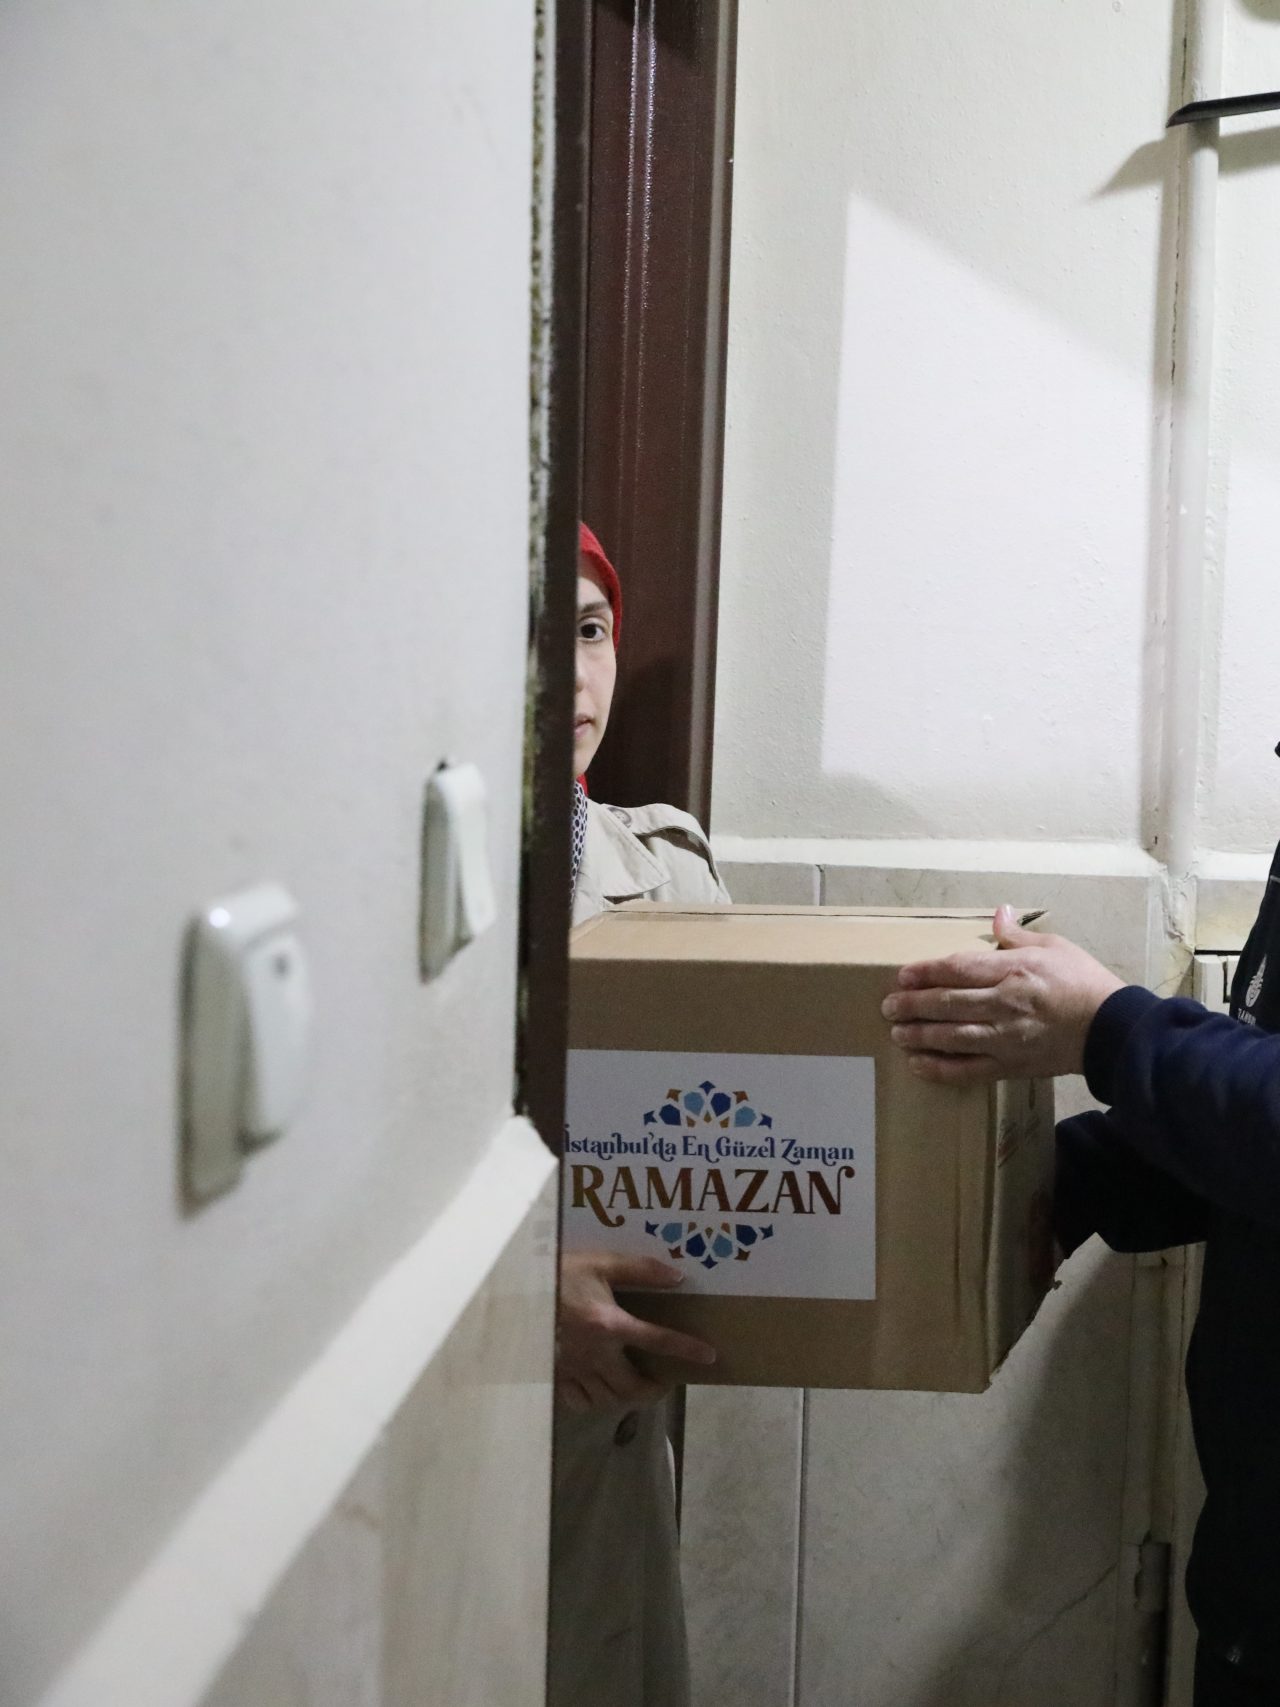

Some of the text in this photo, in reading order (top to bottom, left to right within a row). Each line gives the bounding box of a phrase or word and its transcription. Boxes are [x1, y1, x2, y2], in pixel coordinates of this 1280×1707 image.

[682, 1135, 718, 1164] En
[715, 1135, 776, 1159] Güzel
[781, 1138, 855, 1166] Zaman
[570, 1164, 855, 1228] RAMAZAN
